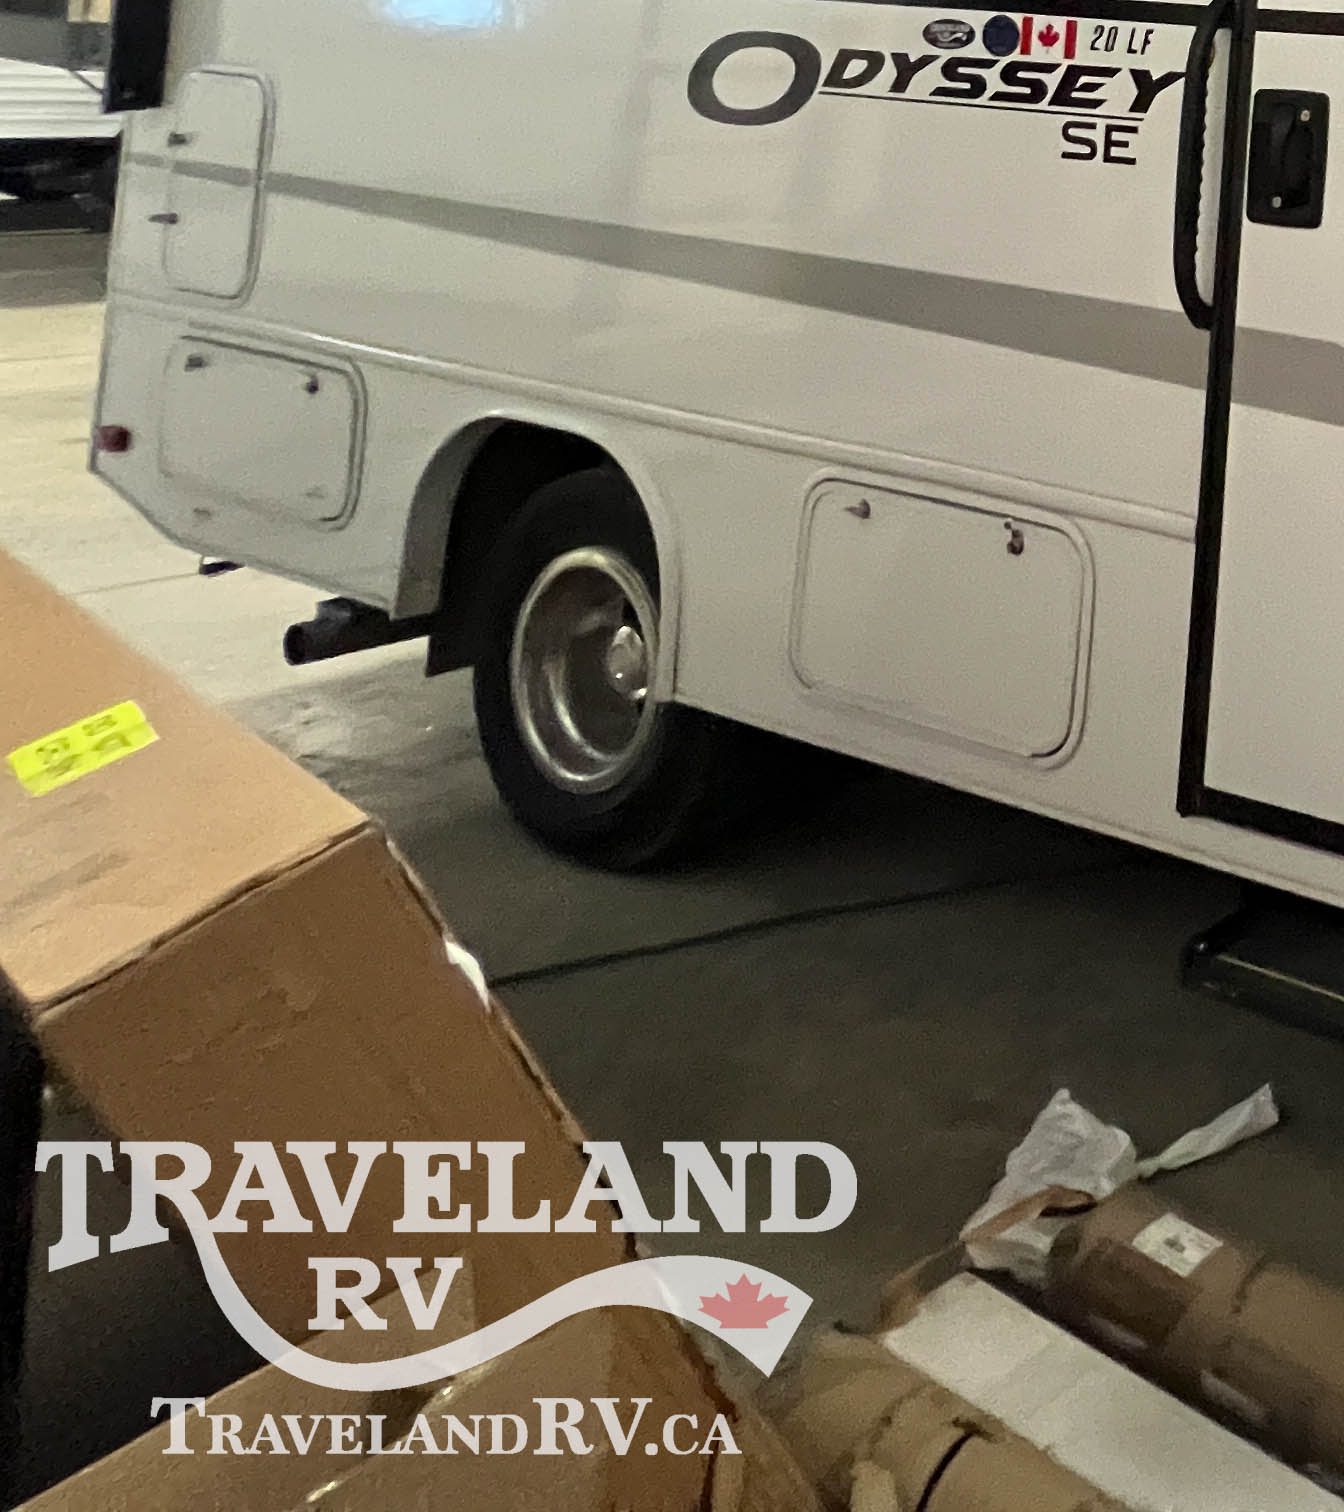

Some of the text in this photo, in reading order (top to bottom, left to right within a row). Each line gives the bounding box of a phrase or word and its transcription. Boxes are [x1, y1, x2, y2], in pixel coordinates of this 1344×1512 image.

[1090, 24, 1155, 55] 20 LF
[687, 30, 1187, 127] ODYSSEY
[1061, 120, 1139, 166] SE
